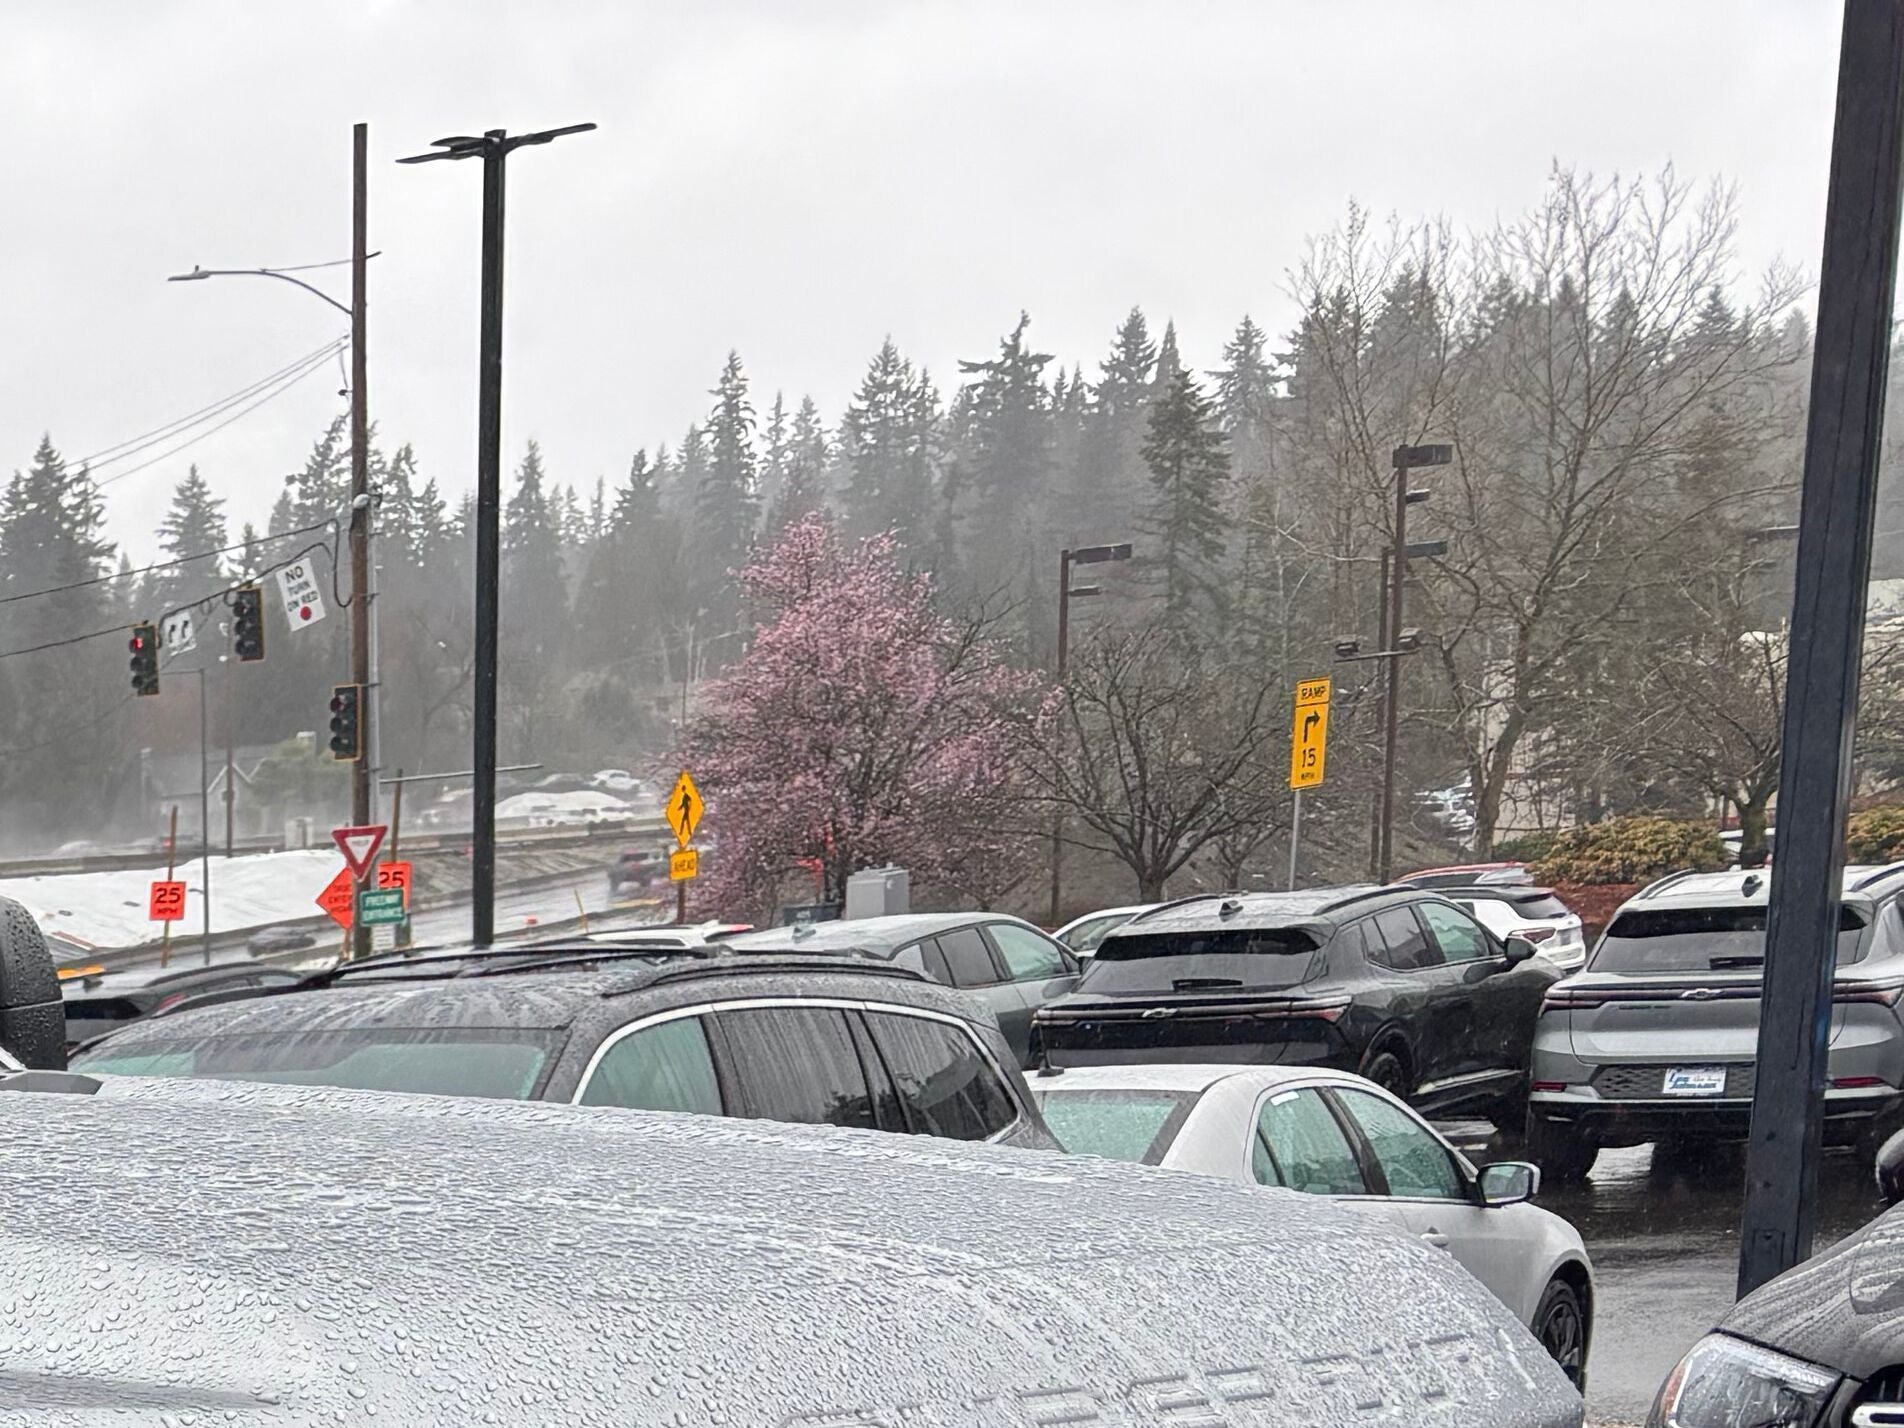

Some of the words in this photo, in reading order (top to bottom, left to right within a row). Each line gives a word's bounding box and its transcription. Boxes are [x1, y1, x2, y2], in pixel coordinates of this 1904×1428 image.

[285, 565, 304, 584] NO
[1302, 747, 1316, 768] 15
[379, 871, 404, 888] 25
[155, 887, 181, 904] 25
